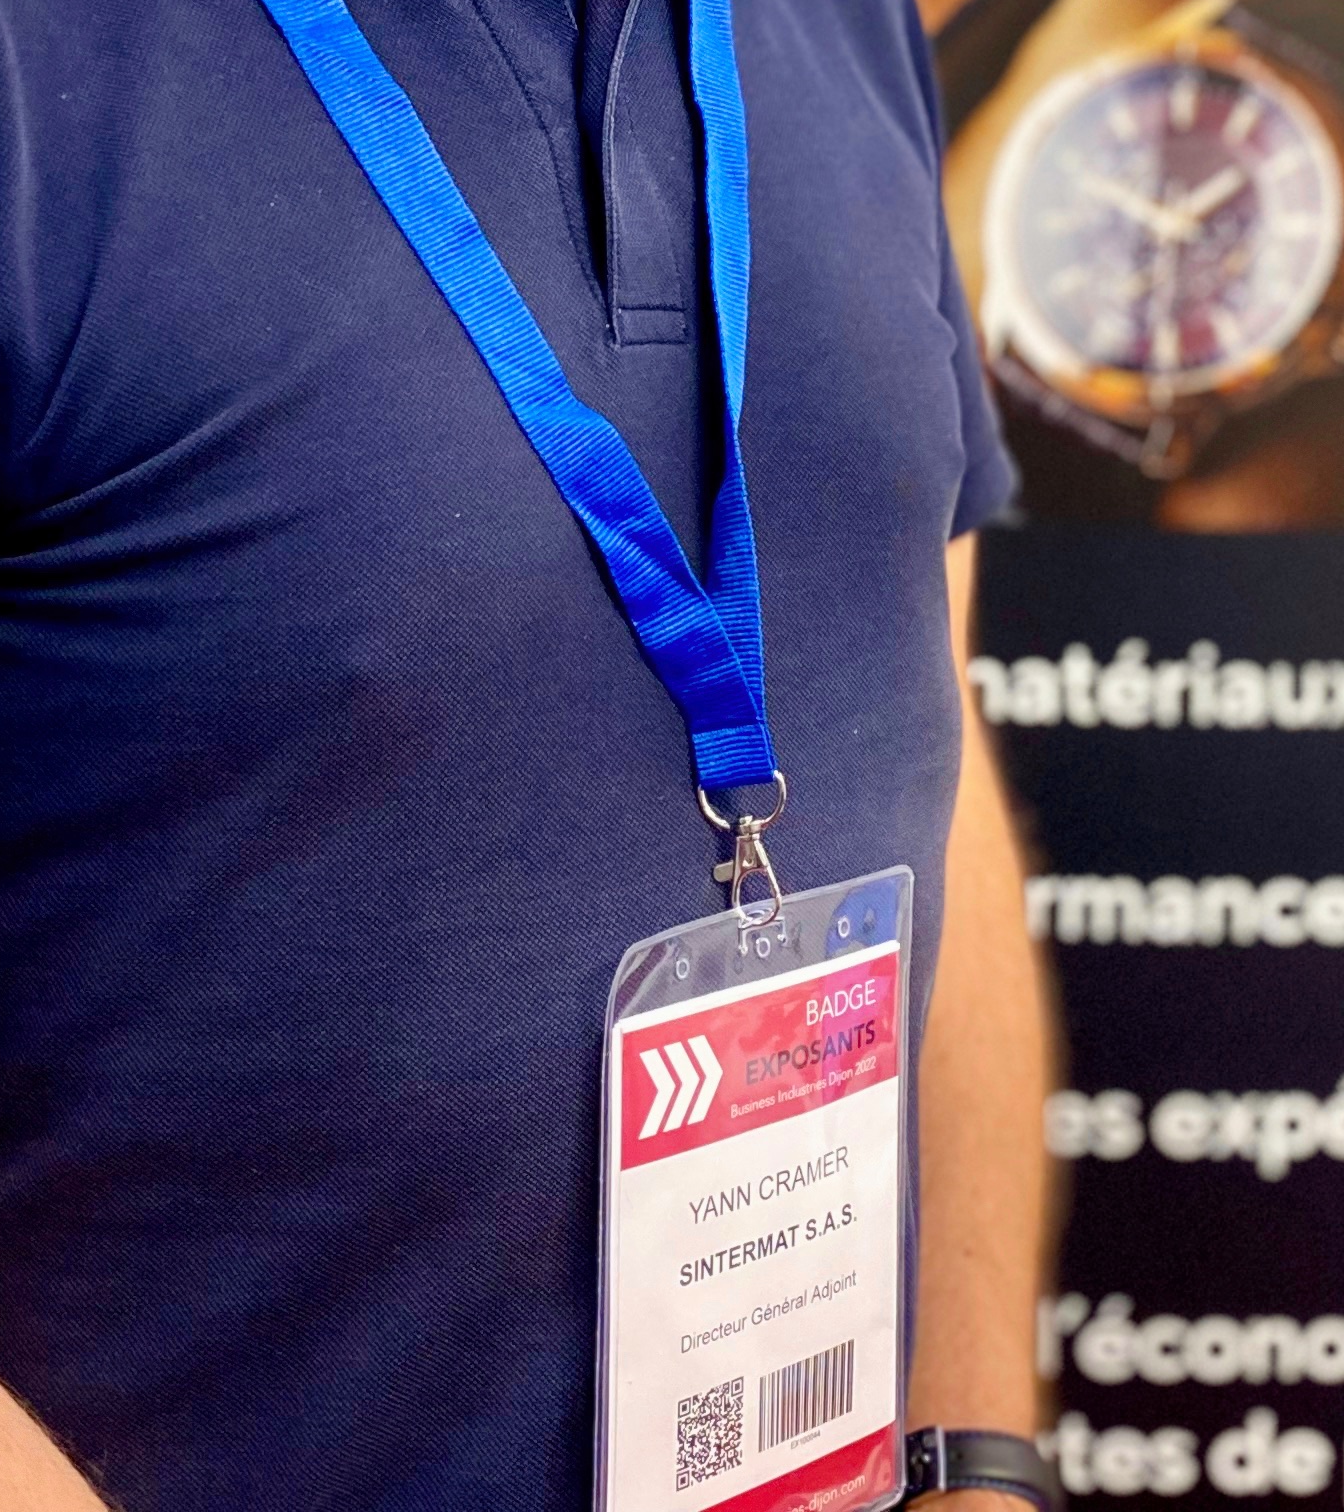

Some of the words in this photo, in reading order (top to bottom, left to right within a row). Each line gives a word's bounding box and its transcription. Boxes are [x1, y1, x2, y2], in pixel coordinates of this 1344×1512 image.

[806, 979, 876, 1026] BADGE
[730, 1094, 775, 1119] Business
[777, 1078, 827, 1103] Industries
[828, 1068, 854, 1086] Dijon
[854, 1056, 877, 1076] 2022
[746, 1020, 876, 1085] EXPOSANTS
[1042, 1088, 1144, 1161] es
[689, 1182, 751, 1224] YANN
[759, 1146, 849, 1201] CRAMER
[679, 1224, 800, 1286] SINTERMAT
[806, 1203, 857, 1241] S.A.S.
[681, 1316, 747, 1354] Directeur
[751, 1288, 807, 1325] Général
[811, 1270, 857, 1304] Adjoint
[1205, 1405, 1336, 1497] de
